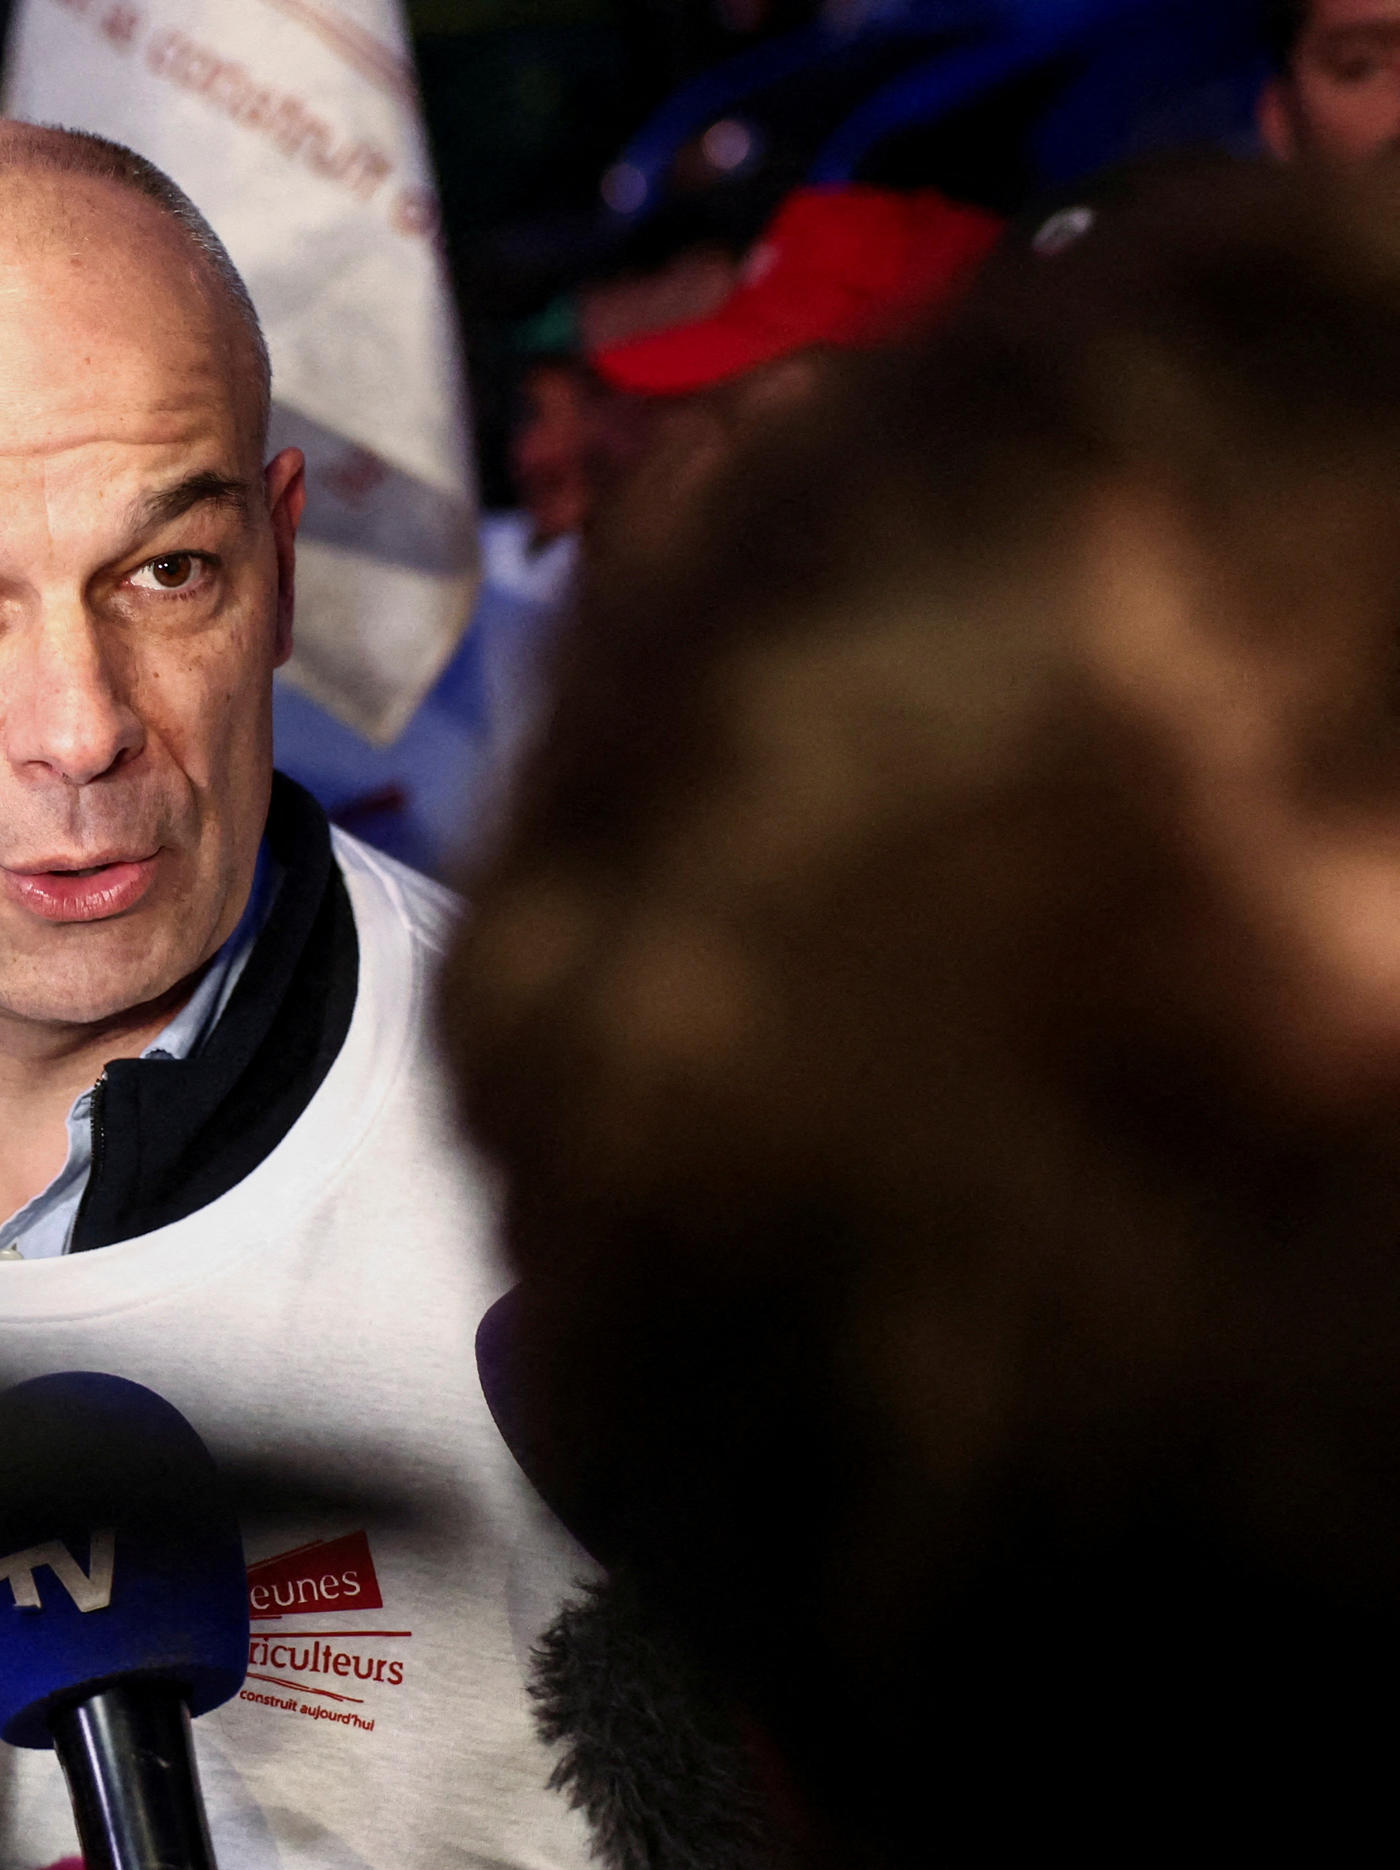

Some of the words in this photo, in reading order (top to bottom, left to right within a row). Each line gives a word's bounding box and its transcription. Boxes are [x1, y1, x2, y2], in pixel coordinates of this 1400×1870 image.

[250, 1571, 361, 1610] eunes
[249, 1637, 404, 1685] riculteurs
[239, 1689, 298, 1712] construit
[299, 1703, 375, 1732] aujourd'hui
